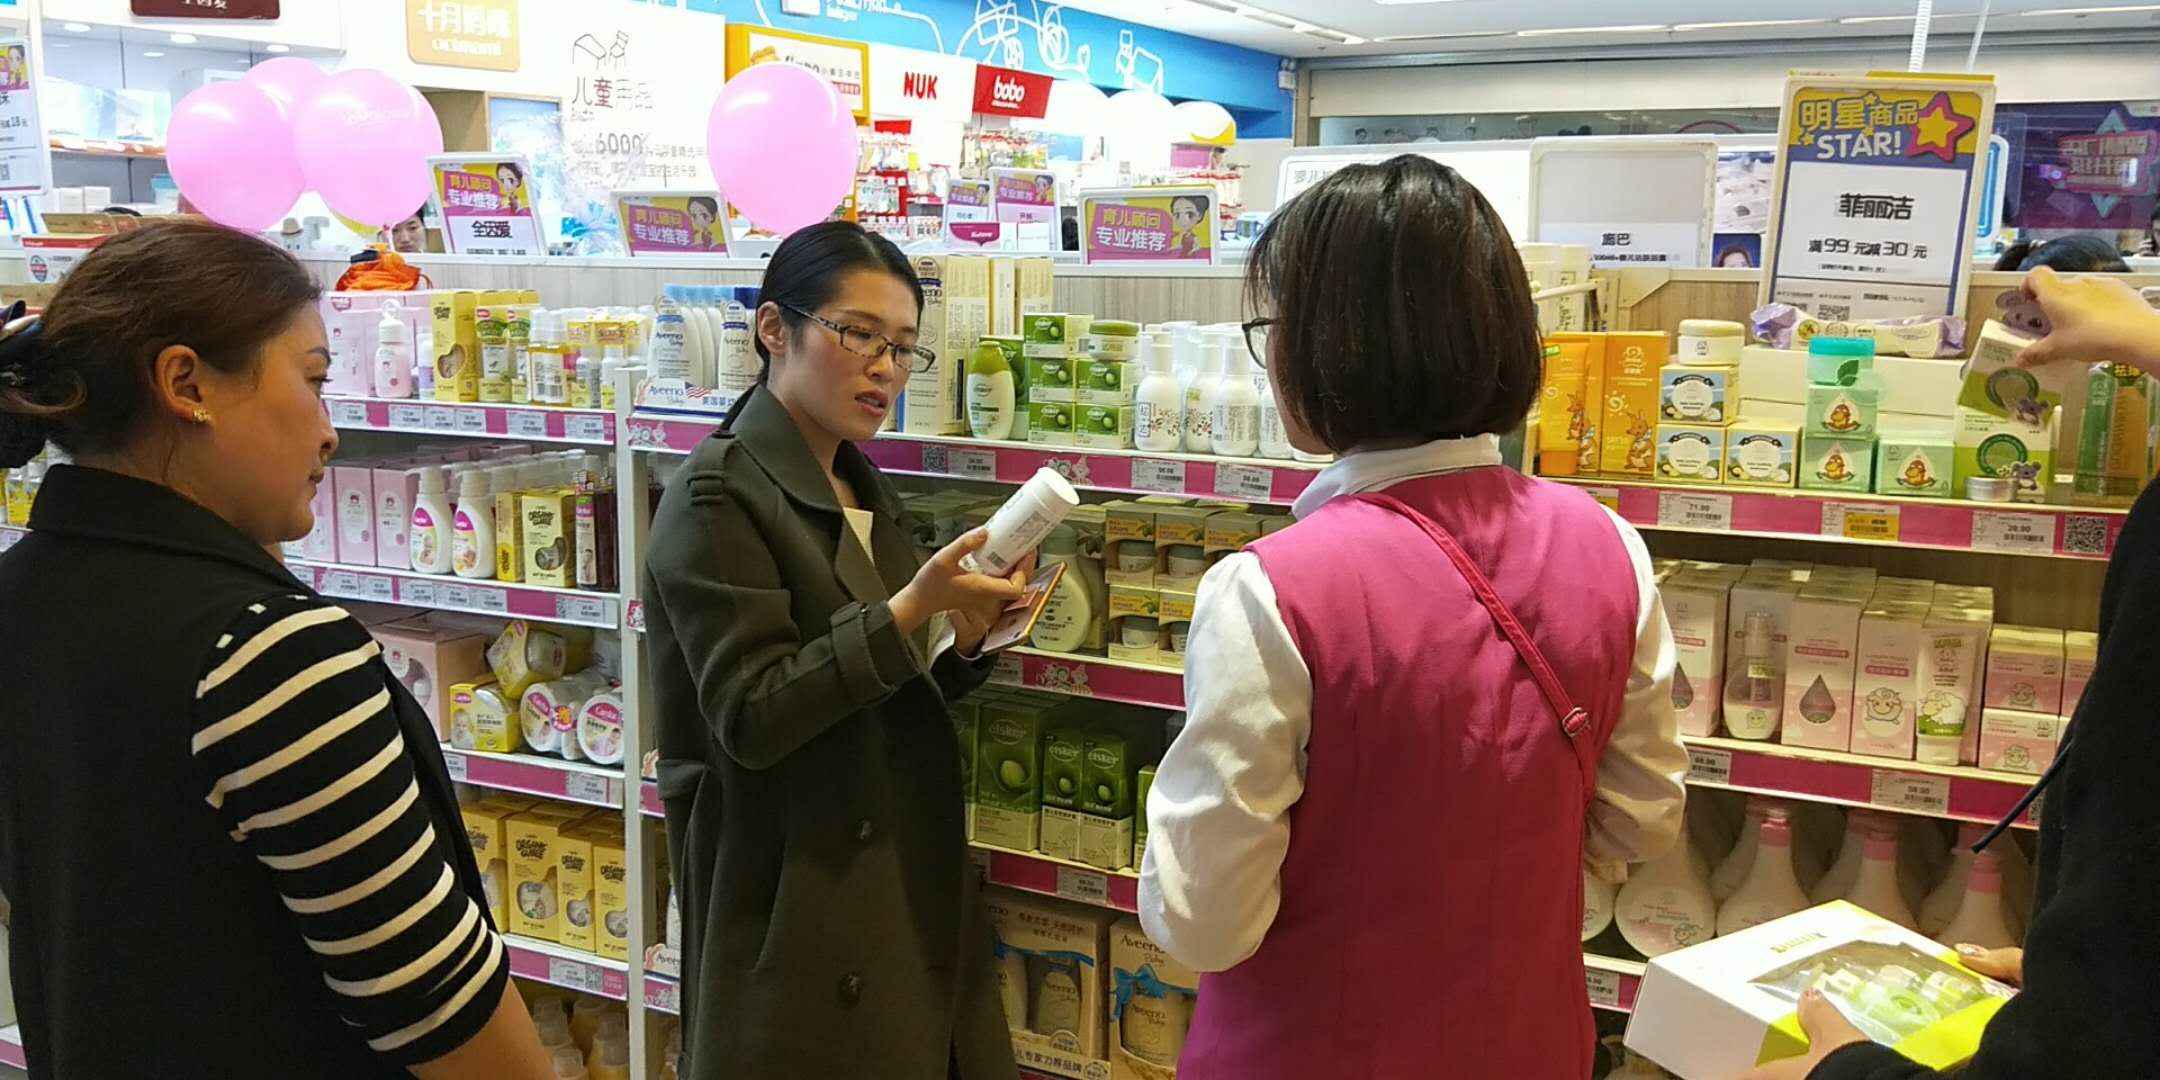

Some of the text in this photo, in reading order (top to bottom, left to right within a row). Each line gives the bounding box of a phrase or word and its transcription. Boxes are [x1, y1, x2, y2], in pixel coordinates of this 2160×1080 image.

[904, 71, 938, 100] NUK
[993, 74, 1025, 103] bobo
[1801, 99, 1919, 131] 明星商品
[1816, 130, 1902, 160] STAR!
[447, 188, 500, 210] 专业推荐
[635, 209, 685, 229] 育儿顾问
[1102, 207, 1162, 229] 育儿顾问
[632, 223, 692, 246] 专业推荐
[1096, 226, 1167, 252] 专业推荐
[656, 331, 684, 342] Aveeno
[648, 384, 685, 398] Aveeno
